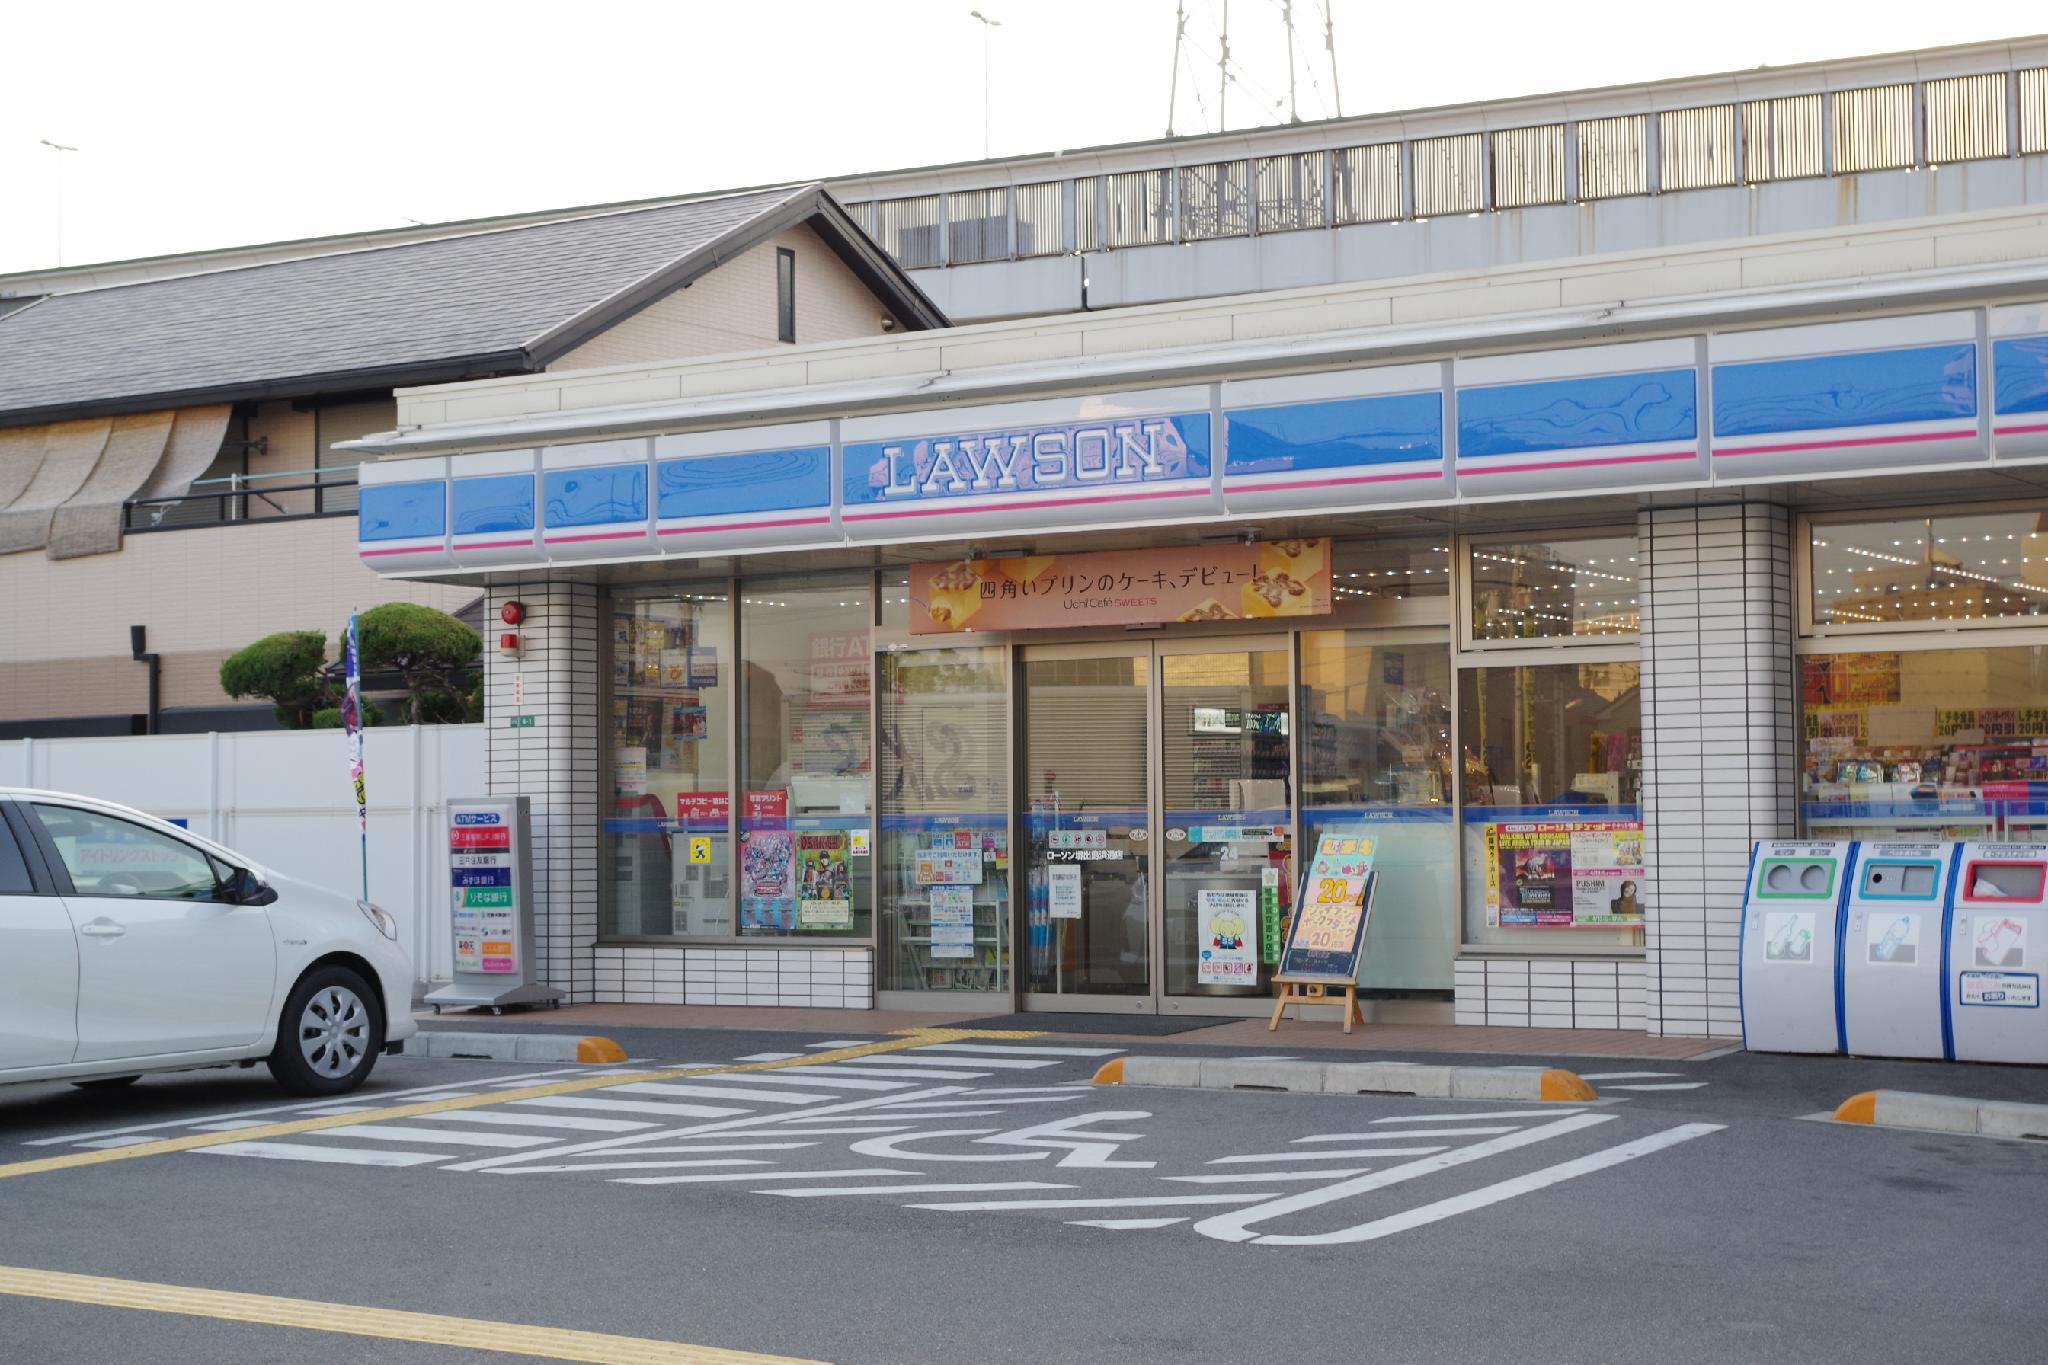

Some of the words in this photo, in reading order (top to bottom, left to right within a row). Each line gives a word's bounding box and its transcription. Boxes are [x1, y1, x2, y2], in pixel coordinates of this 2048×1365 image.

[882, 422, 1164, 497] LAWSON
[1114, 597, 1158, 607] SWEETS
[470, 892, 508, 903] りそな銀行
